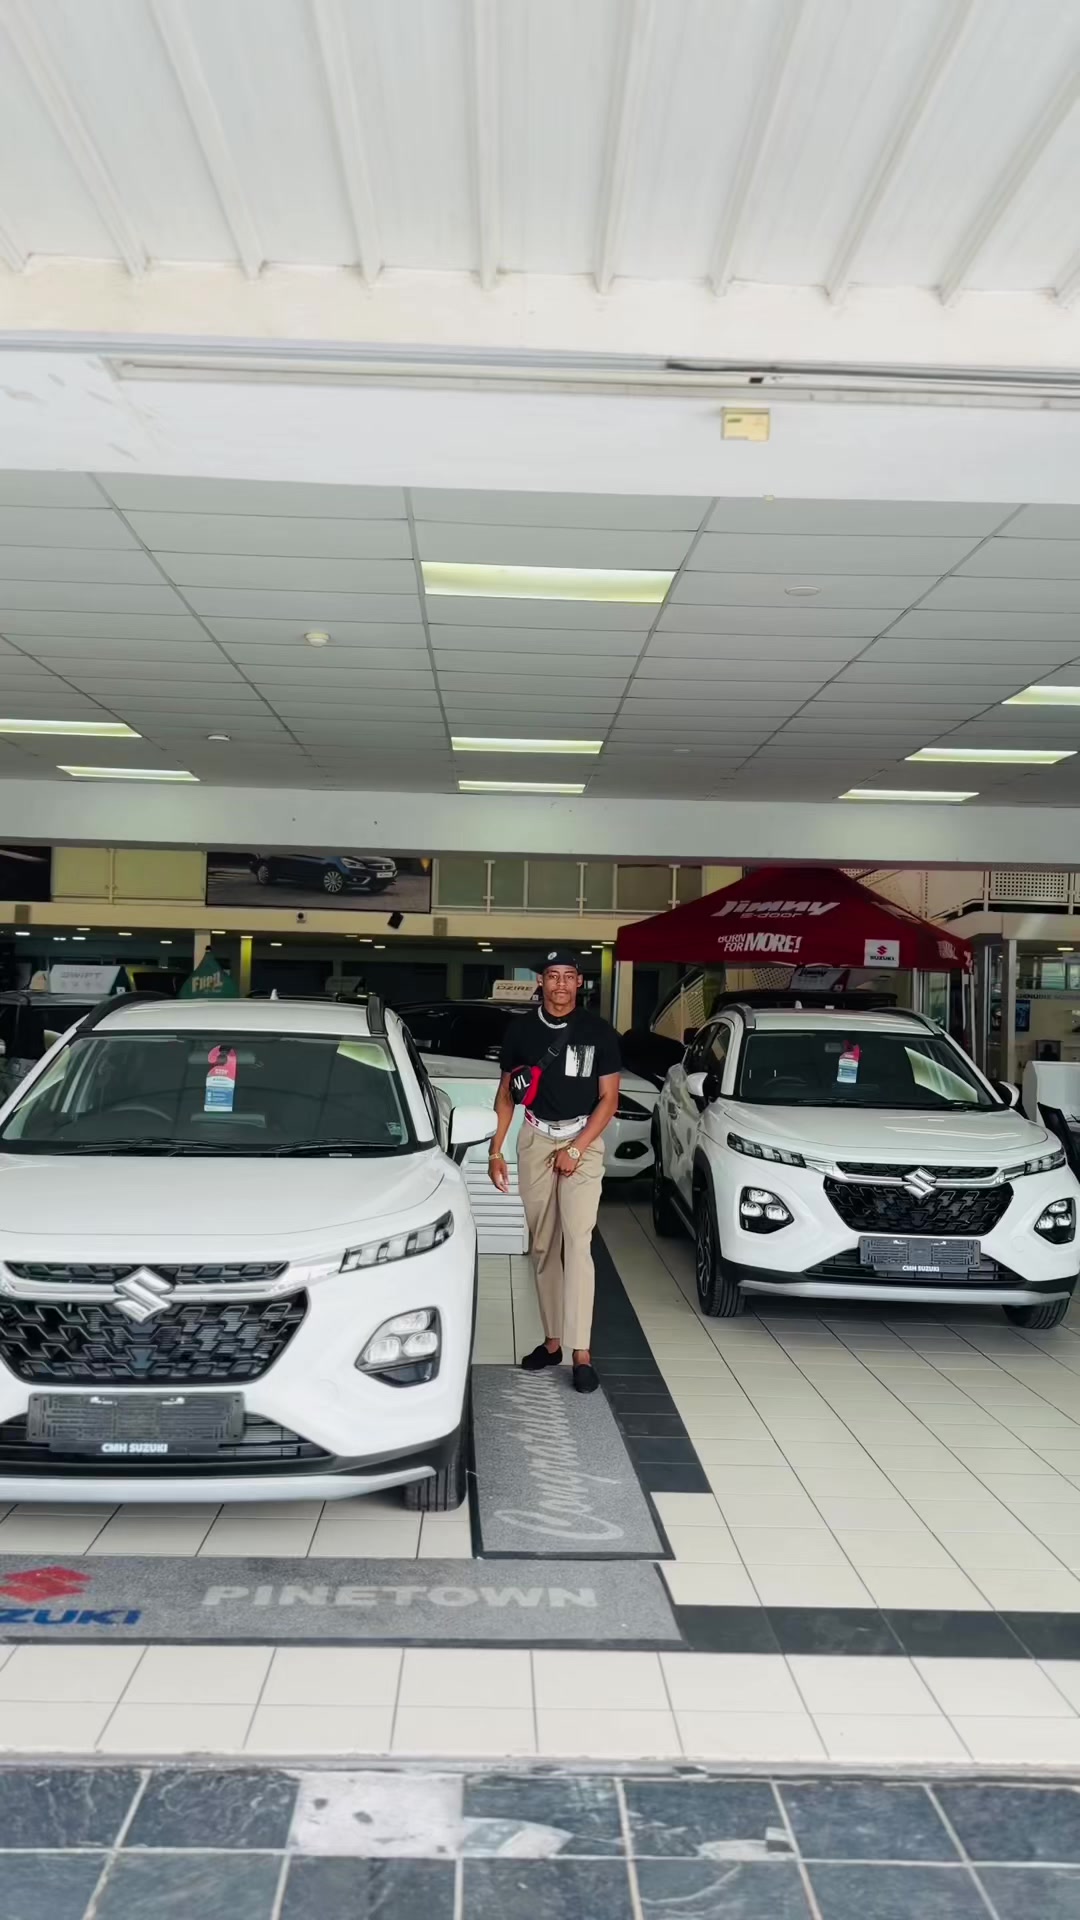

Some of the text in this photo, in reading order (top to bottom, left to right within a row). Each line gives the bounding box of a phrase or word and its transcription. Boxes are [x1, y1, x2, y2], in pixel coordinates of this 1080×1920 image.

[710, 900, 841, 917] Jimny
[723, 932, 803, 953] FOR MORE!
[101, 1443, 168, 1453] CMH SUZUKI
[200, 1585, 599, 1608] PINETOWN
